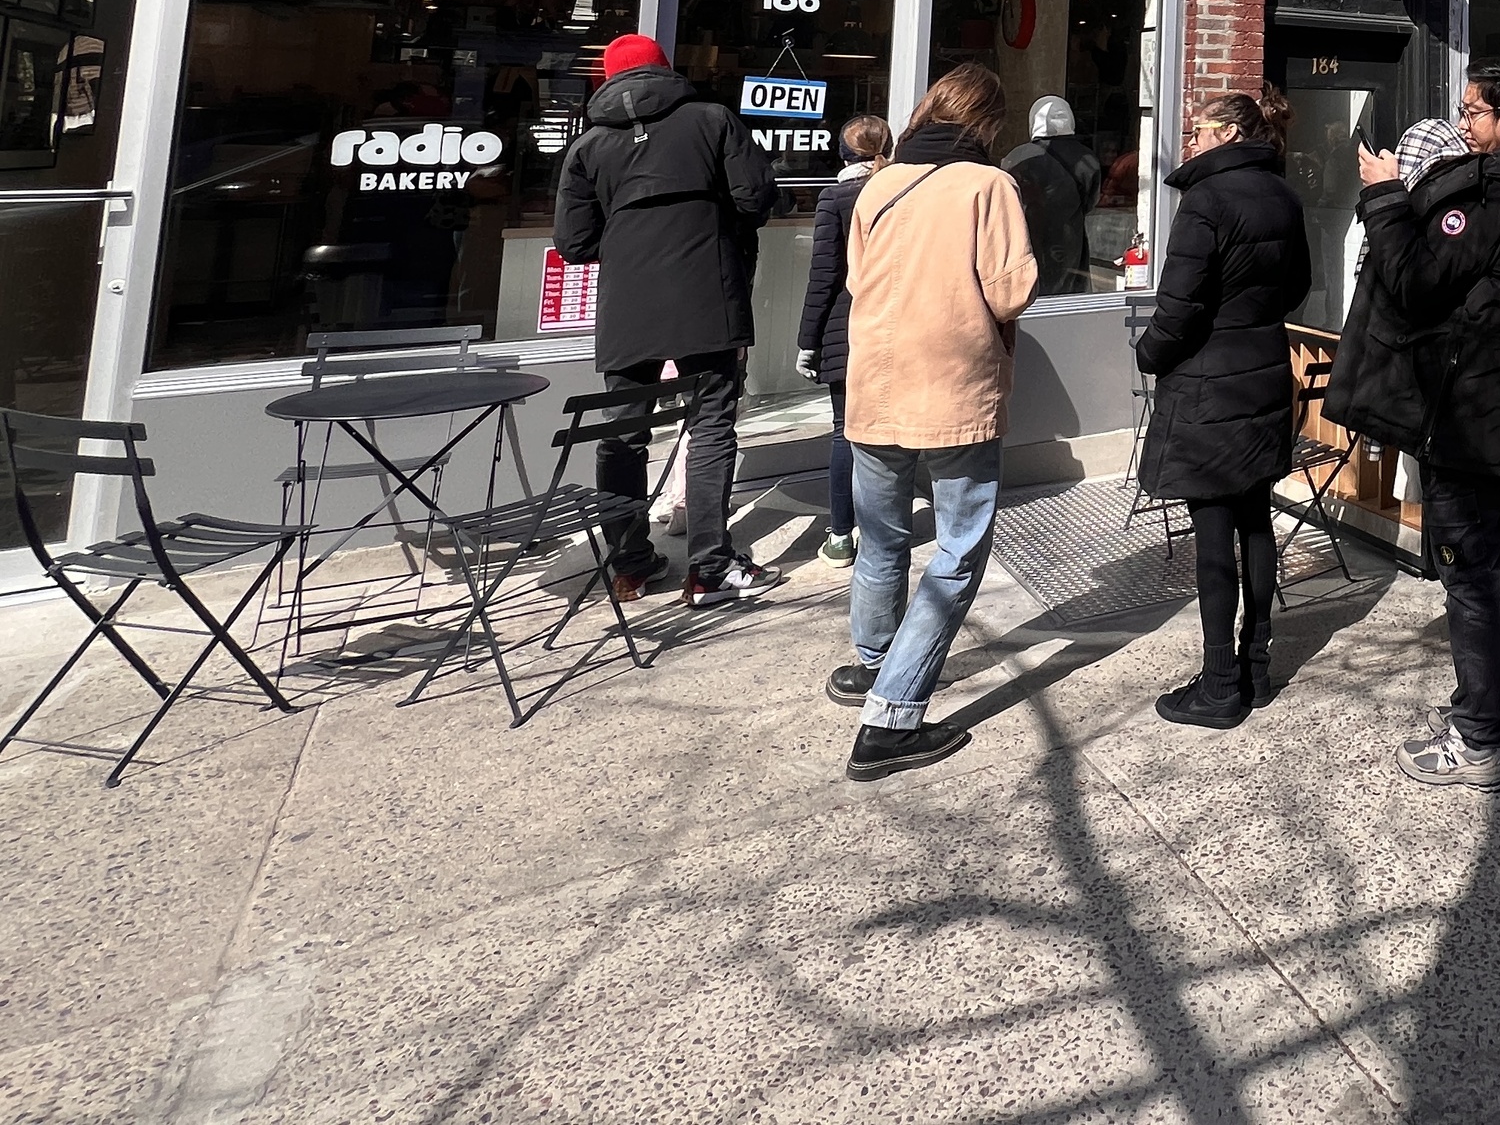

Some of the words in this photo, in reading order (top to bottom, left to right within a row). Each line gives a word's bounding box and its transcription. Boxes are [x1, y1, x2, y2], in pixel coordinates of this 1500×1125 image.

[1312, 56, 1339, 75] 184
[751, 84, 819, 112] OPEN
[330, 123, 503, 167] radio
[751, 128, 832, 151] NTER
[359, 171, 471, 191] BAKERY
